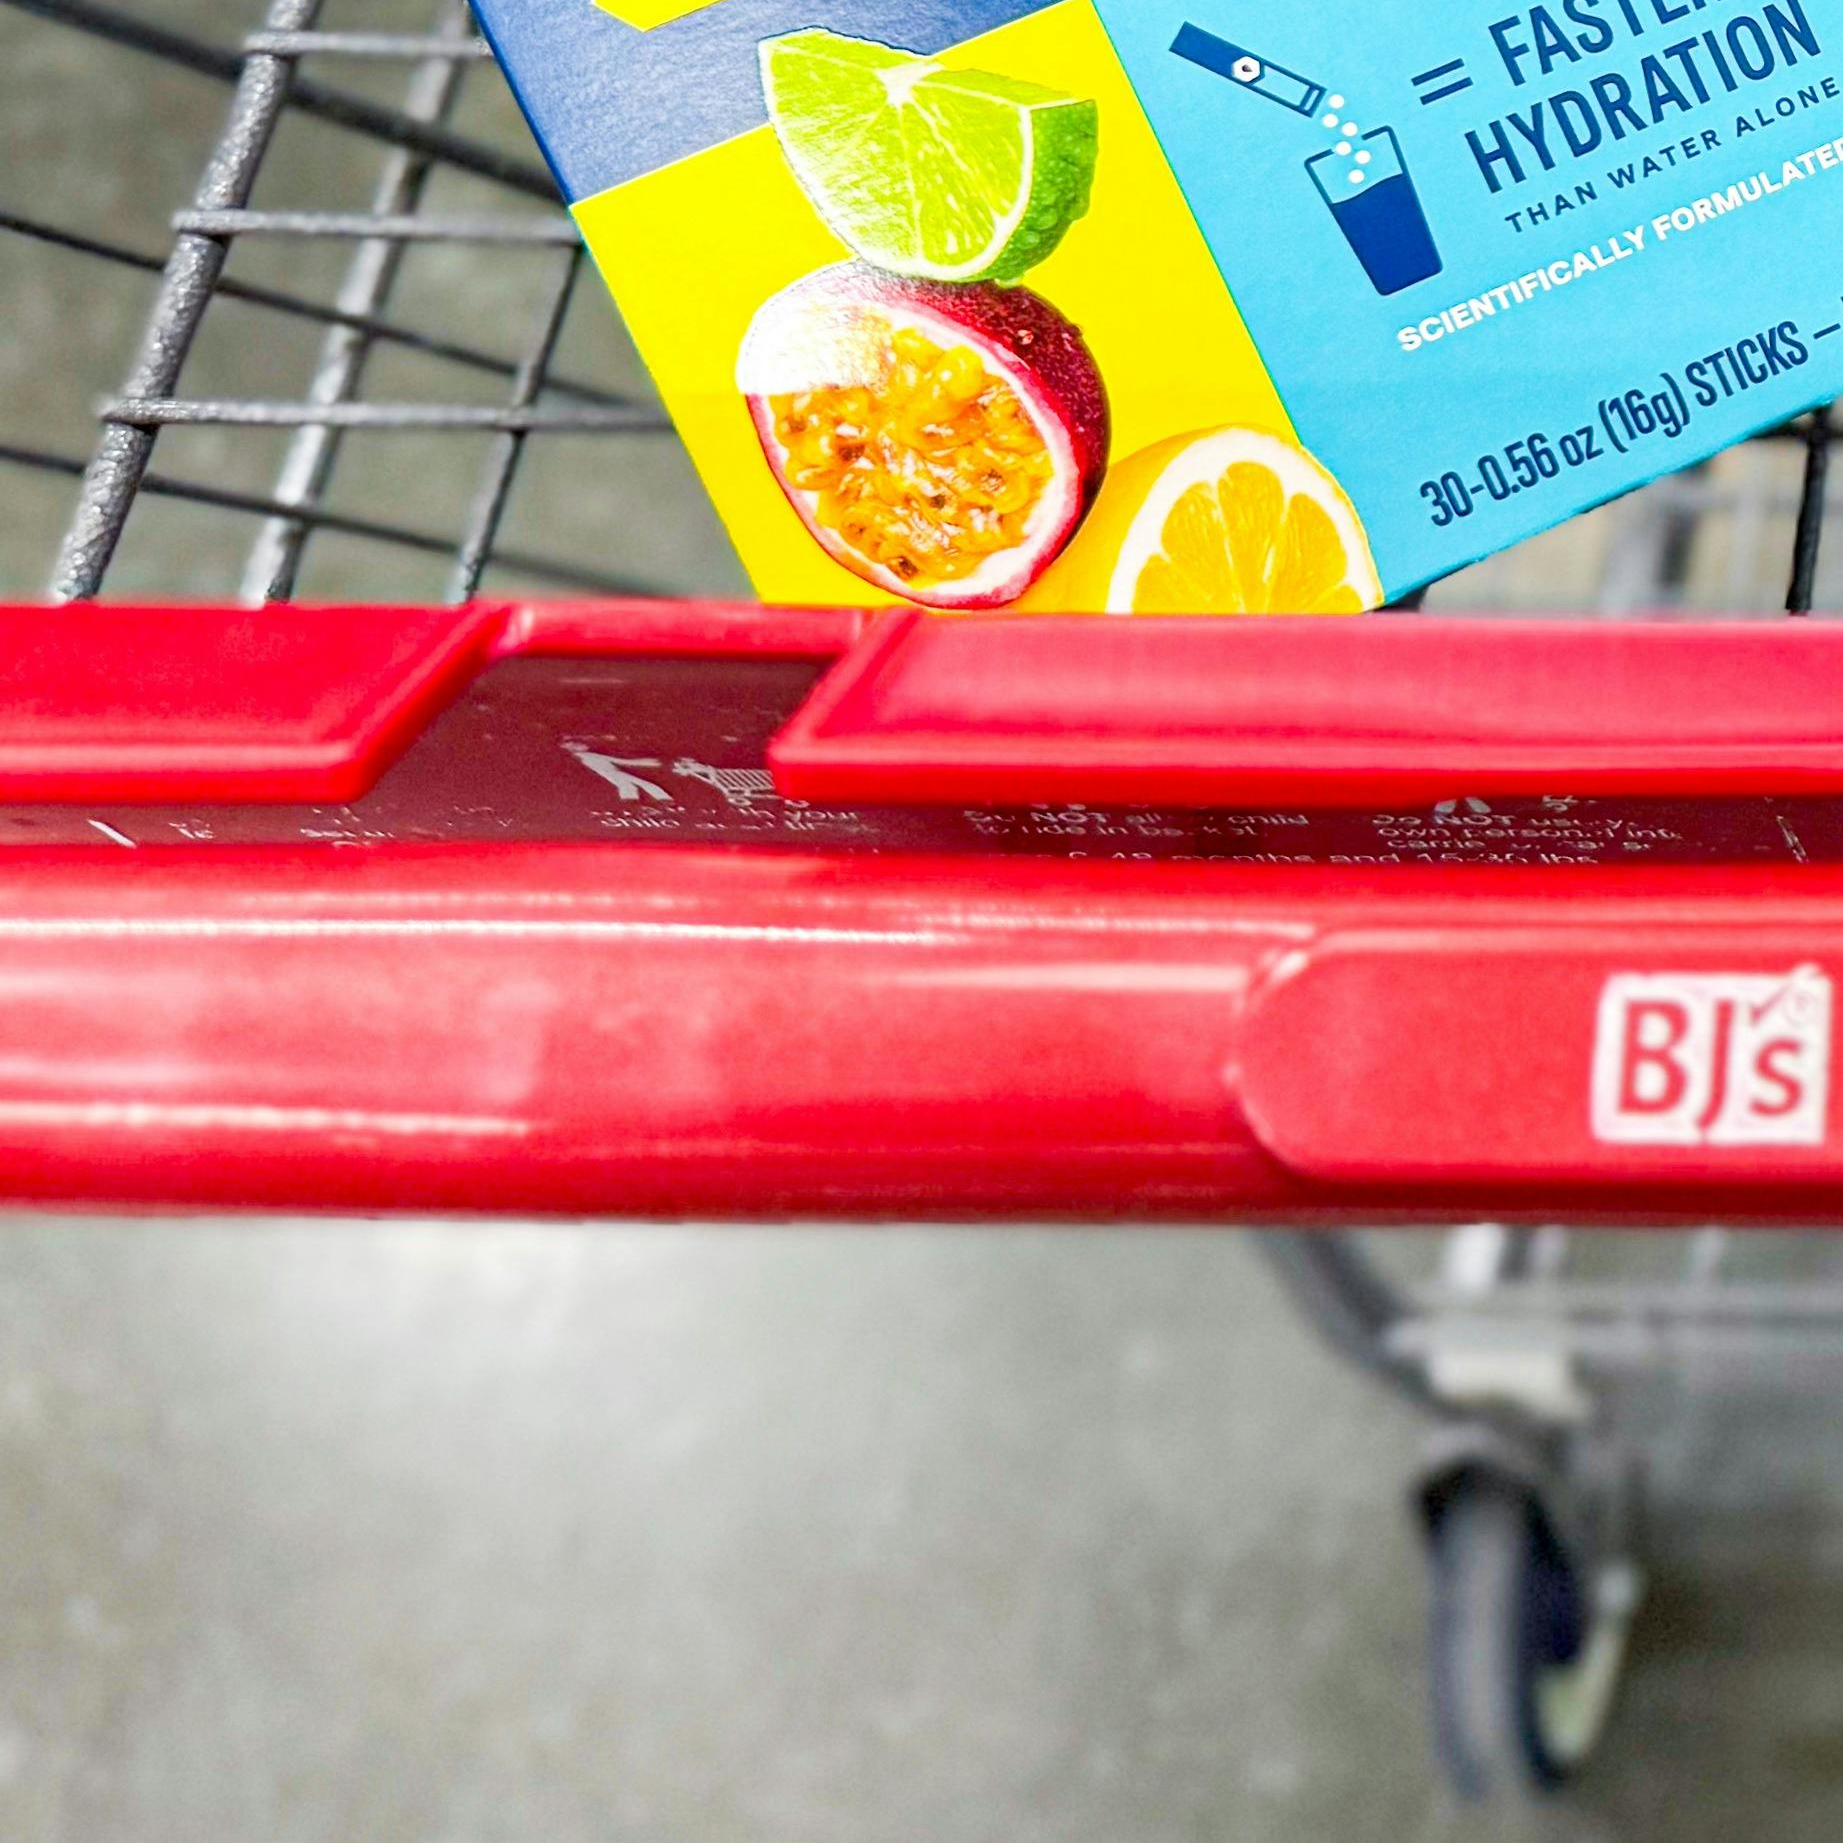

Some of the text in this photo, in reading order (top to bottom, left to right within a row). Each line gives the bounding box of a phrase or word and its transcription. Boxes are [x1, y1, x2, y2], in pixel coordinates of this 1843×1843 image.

[1504, 76, 1842, 235] THAN WATER ALONE
[1397, 226, 1648, 353] SCIENTIFICALLY
[1596, 371, 1691, 453] (16g)
[1684, 320, 1811, 408] STICKS
